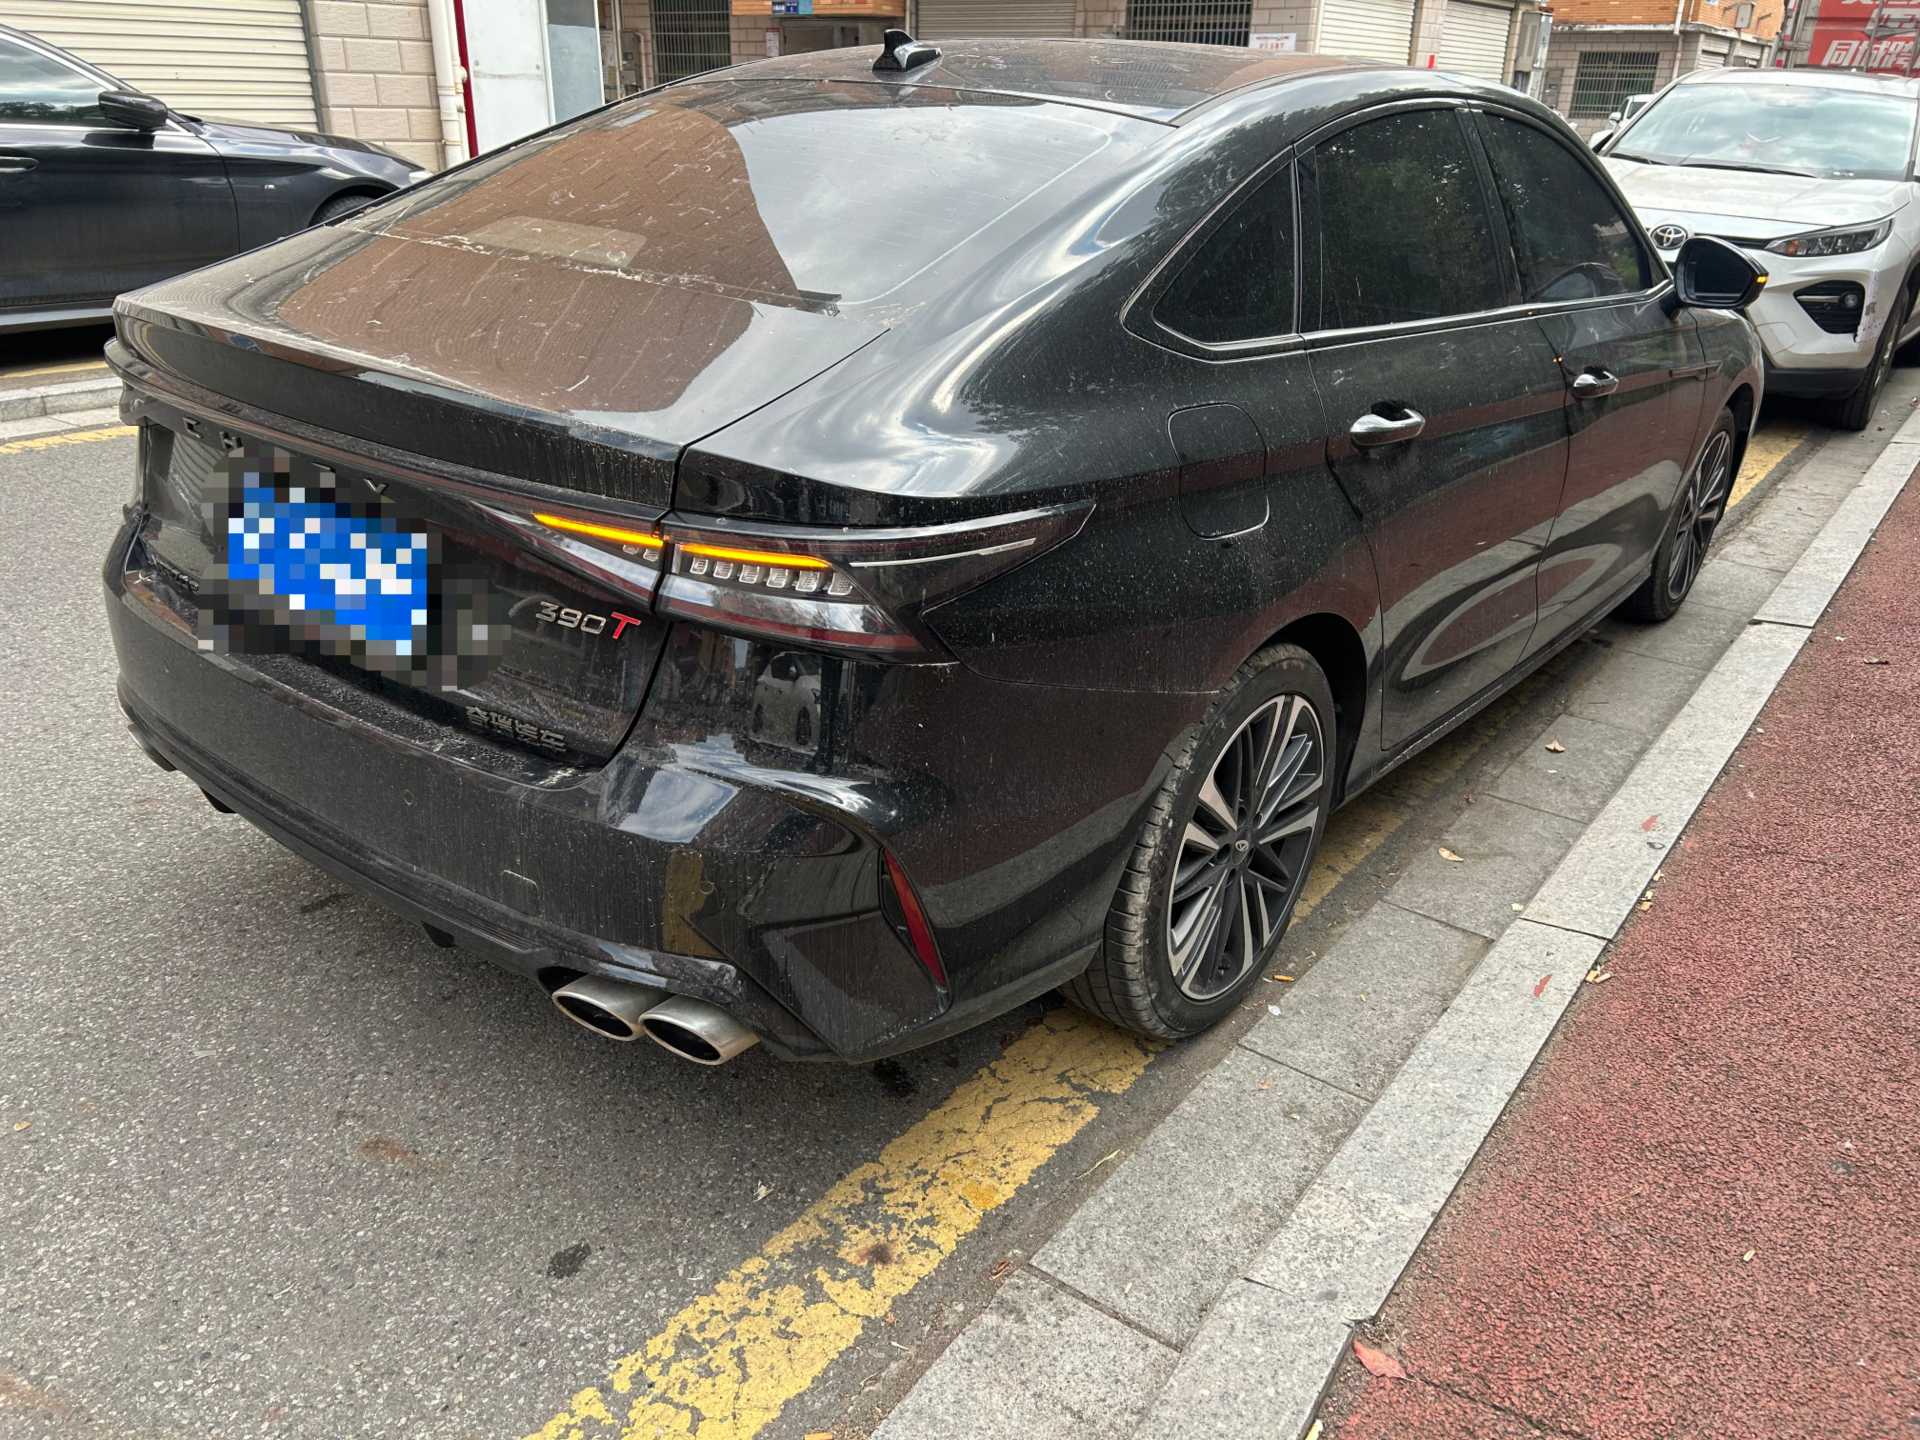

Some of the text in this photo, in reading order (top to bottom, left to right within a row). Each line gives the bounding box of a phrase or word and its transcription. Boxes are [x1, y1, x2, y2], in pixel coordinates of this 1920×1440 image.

[1822, 39, 1920, 68] 同城跨
[535, 601, 642, 640] 390T
